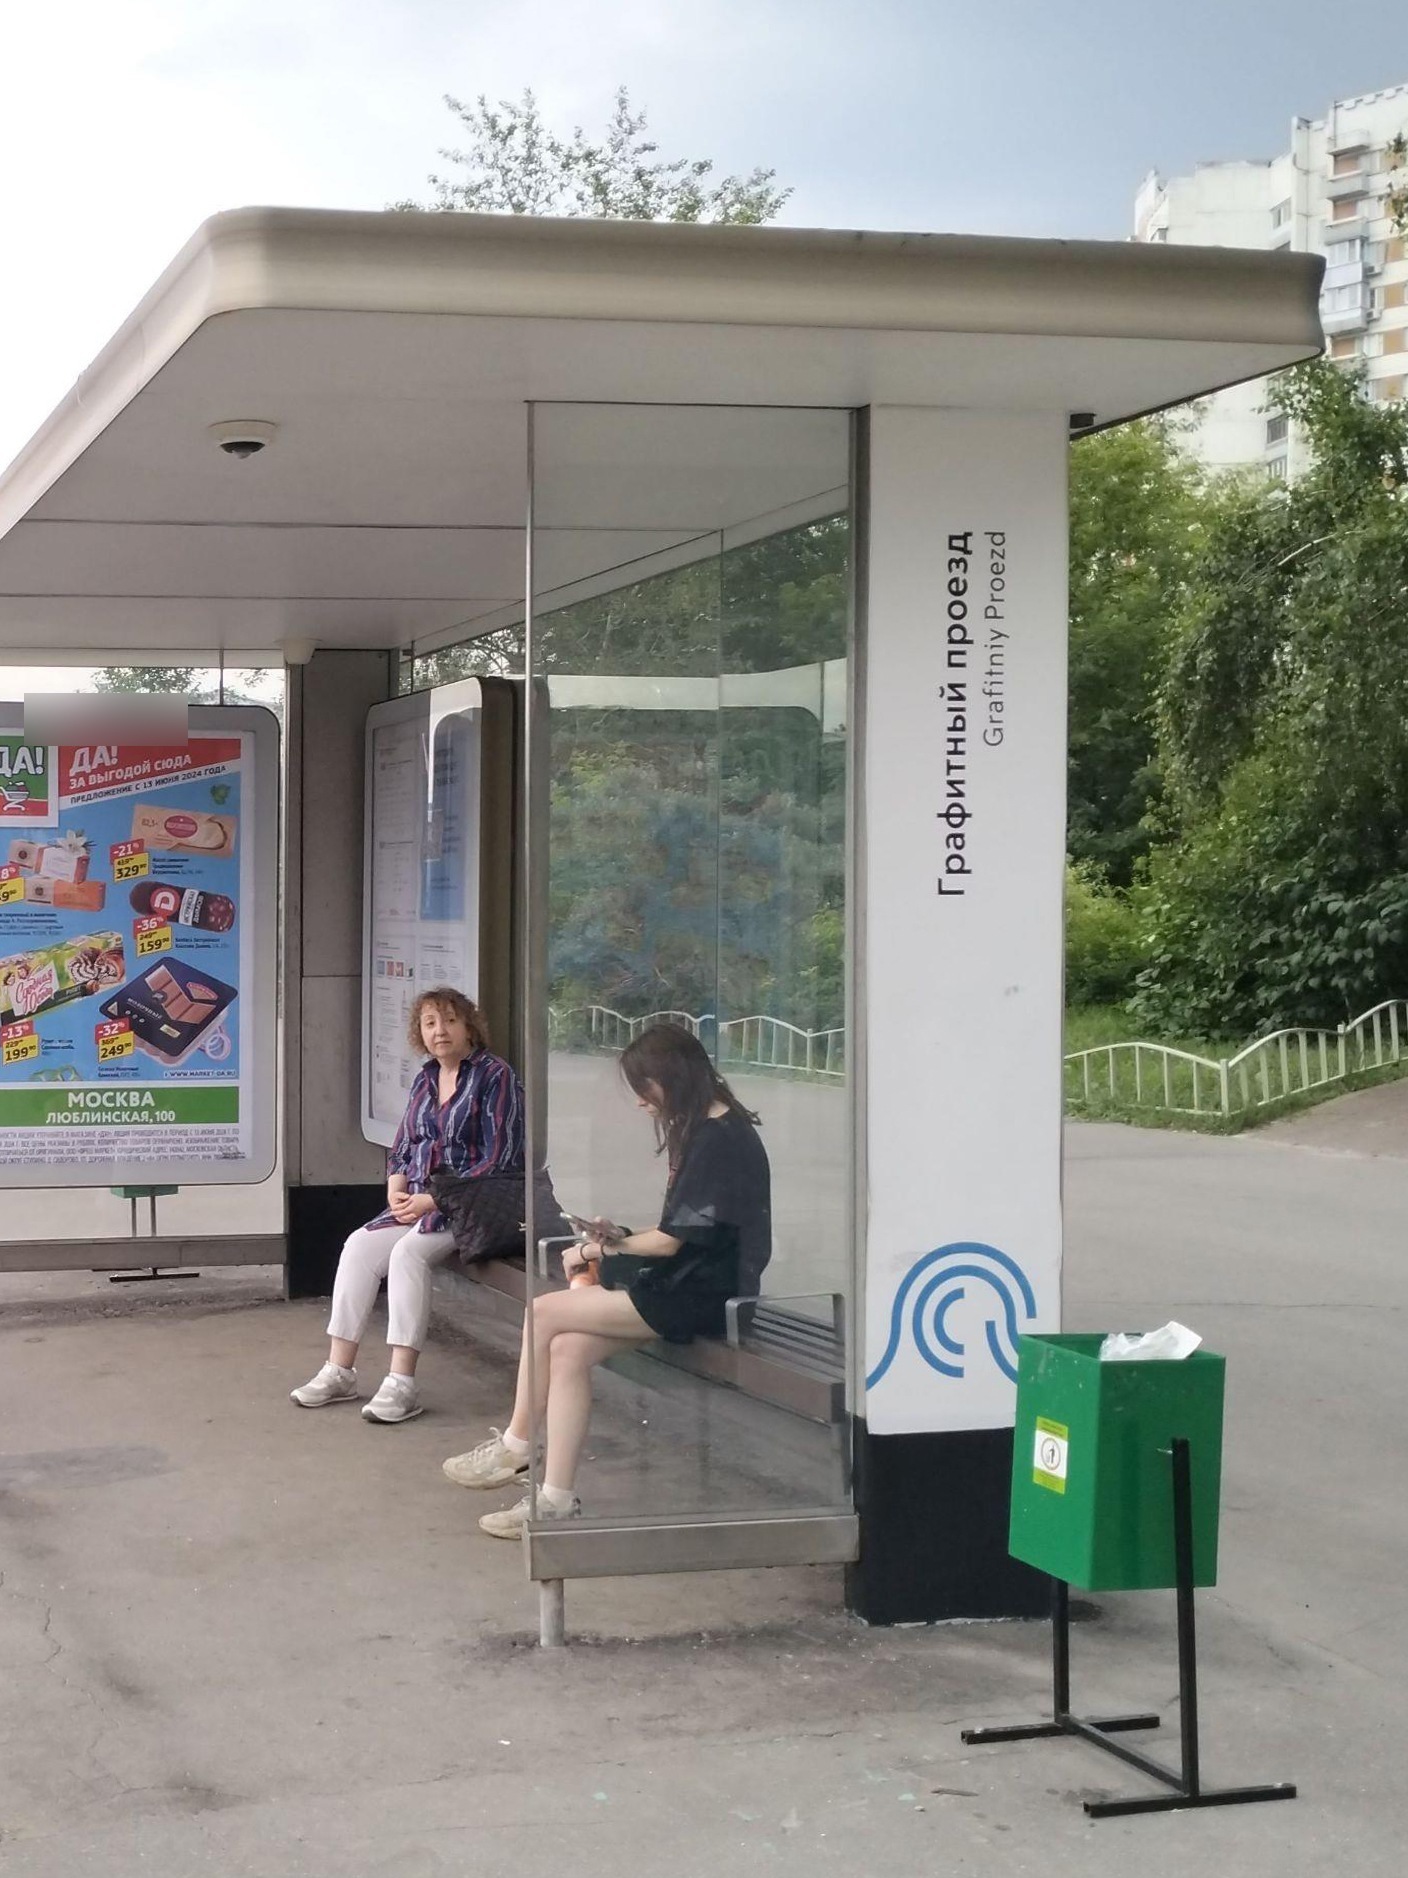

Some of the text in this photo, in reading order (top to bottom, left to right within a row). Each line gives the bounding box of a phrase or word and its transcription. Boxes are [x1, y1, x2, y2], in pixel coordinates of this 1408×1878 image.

[983, 531, 1010, 747] Grafitniy Proezd
[936, 531, 973, 896] Графитный проезд
[69, 746, 118, 777] ДА!
[69, 754, 192, 790] ЗА ВЫГОДОЙ СЮДА
[70, 785, 133, 805] ПРЕДЛОЖЕНИЕ
[182, 769, 202, 782] 2024
[204, 764, 227, 777] ГОДА
[46, 1110, 176, 1124] ЛЮБЛИНСКАЯ, 100
[67, 1091, 155, 1108] МОСКВА
